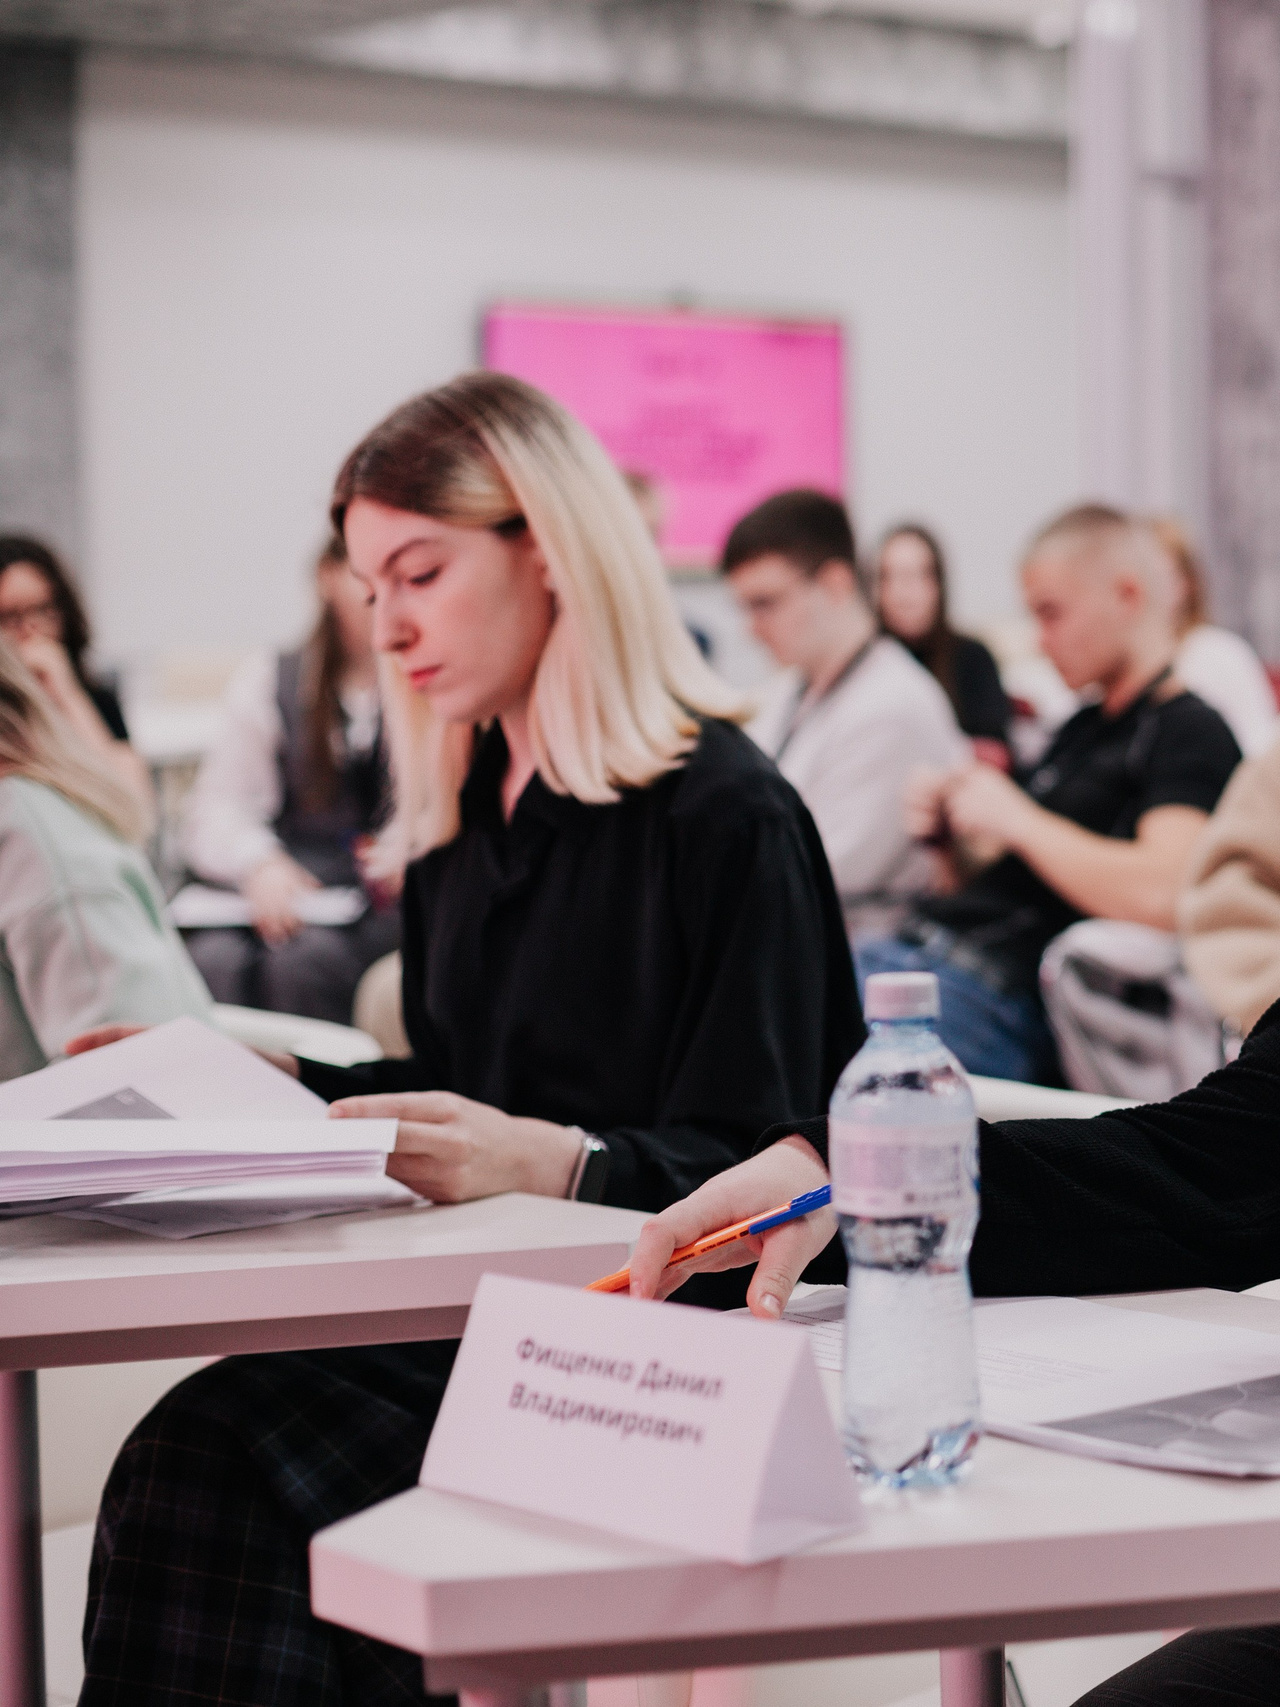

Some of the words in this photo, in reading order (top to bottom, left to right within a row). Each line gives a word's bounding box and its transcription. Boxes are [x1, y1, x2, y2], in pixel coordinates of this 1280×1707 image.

[516, 1337, 635, 1381] Фищенко
[635, 1358, 723, 1398] Данил
[508, 1381, 704, 1445] Владимирович
